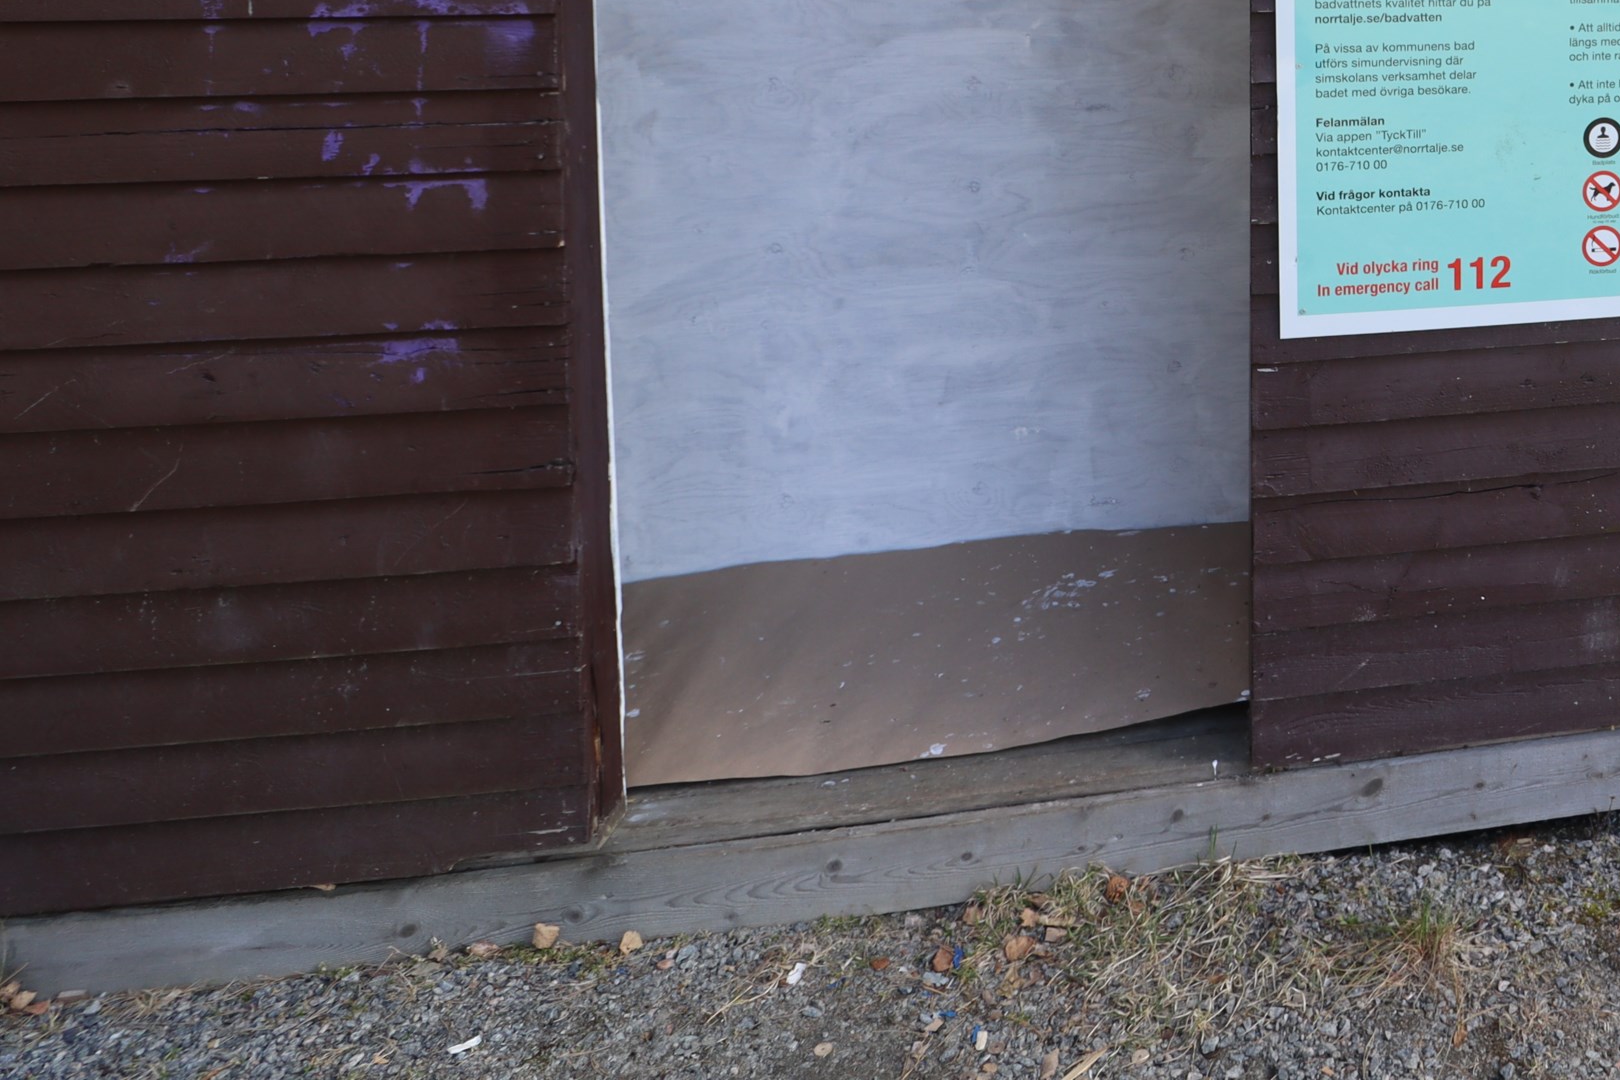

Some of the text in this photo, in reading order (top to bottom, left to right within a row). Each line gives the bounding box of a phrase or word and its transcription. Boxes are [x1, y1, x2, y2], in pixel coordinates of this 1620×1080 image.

[1315, 0, 1382, 9] badvattnets
[1315, 13, 1442, 25] norrtalje.se/badvatten
[1578, 22, 1593, 32] Att
[1596, 22, 1620, 32] alltid
[1315, 41, 1475, 54] På vissa av kommunens bad
[1569, 37, 1597, 49] längs
[1315, 56, 1463, 68] utförs simundervisning där
[1569, 51, 1589, 61] och
[1592, 51, 1611, 60] inte
[1315, 70, 1476, 83] simskolans verksamhet delar
[1578, 79, 1593, 89] Att
[1596, 79, 1615, 88] inte
[1316, 85, 1470, 98] badet med övriga besökare.
[1569, 94, 1594, 105] dyka
[1597, 93, 1611, 105] på
[1316, 117, 1385, 127] Felanmälan
[1316, 133, 1333, 143] Via
[1337, 131, 1372, 143] appen
[1316, 143, 1463, 157] kontaktcenter@norrtalje.se
[1316, 160, 1387, 172] 0176-710 00
[1316, 187, 1430, 201] Vid frågor kontakta
[1317, 198, 1485, 216] Kontaktcenter på 0176-710 00
[1337, 258, 1439, 276] Vid olycka ring
[1448, 255, 1511, 291] 112
[1317, 278, 1439, 297] In emergency call
